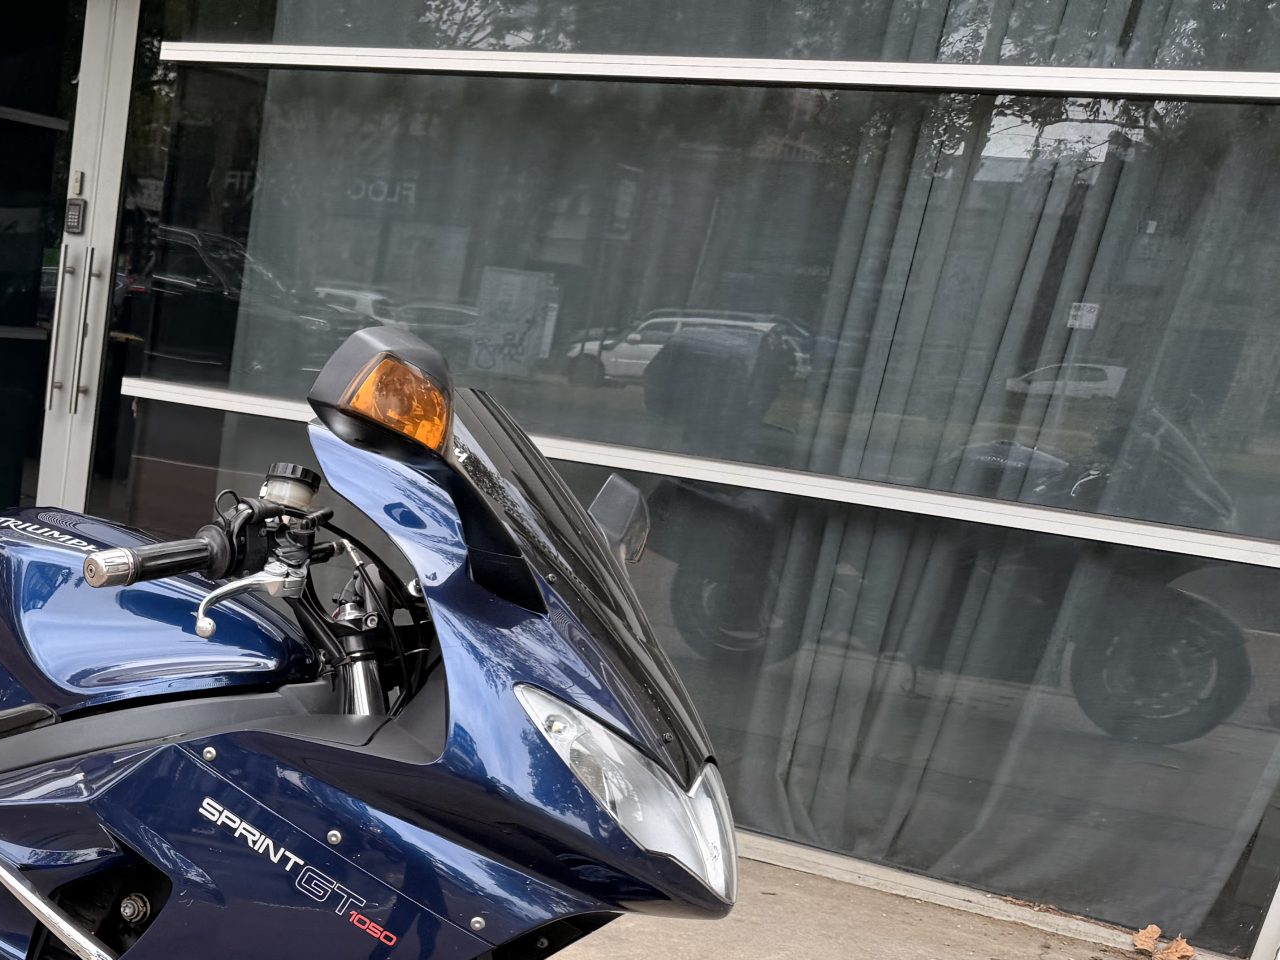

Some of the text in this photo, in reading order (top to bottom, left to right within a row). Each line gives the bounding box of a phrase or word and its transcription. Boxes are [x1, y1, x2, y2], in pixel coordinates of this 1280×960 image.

[198, 797, 398, 946] SPRINT GT 1050
